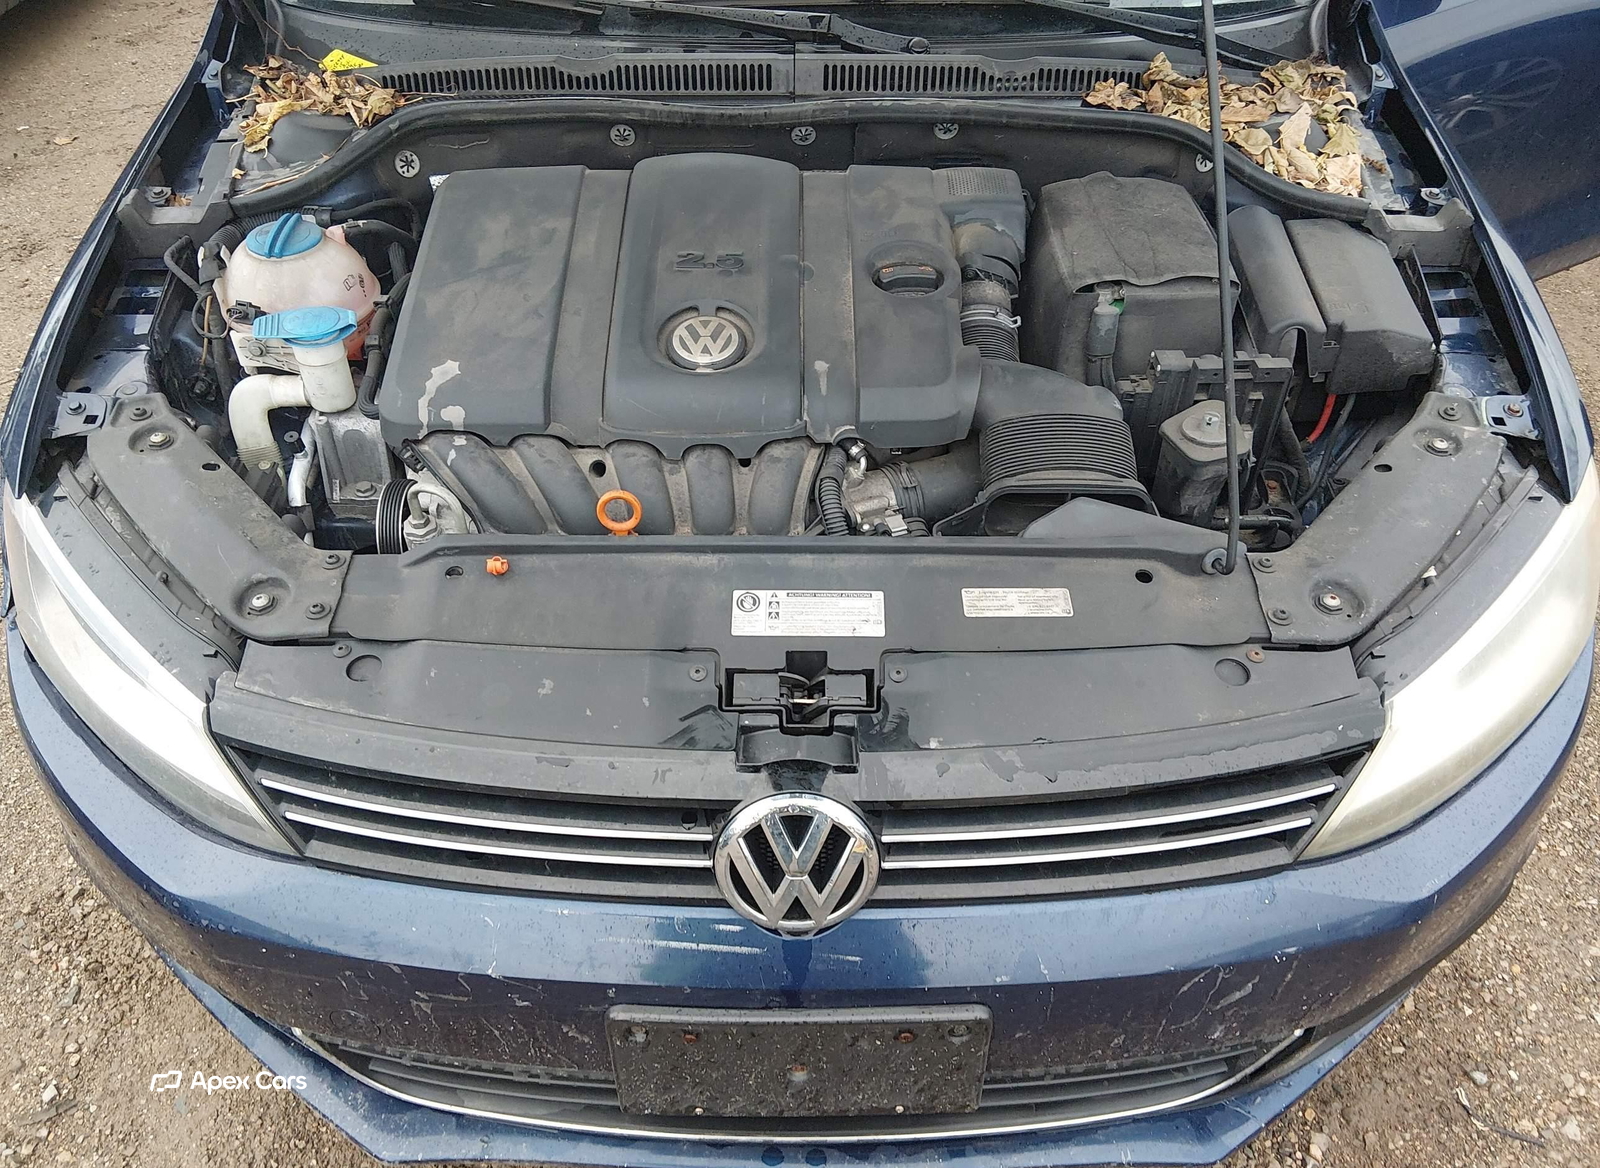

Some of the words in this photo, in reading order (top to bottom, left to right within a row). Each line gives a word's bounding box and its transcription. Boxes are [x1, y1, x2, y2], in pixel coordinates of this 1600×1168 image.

[675, 251, 744, 270] 2.5
[673, 315, 739, 362] VW
[714, 791, 881, 933] VW
